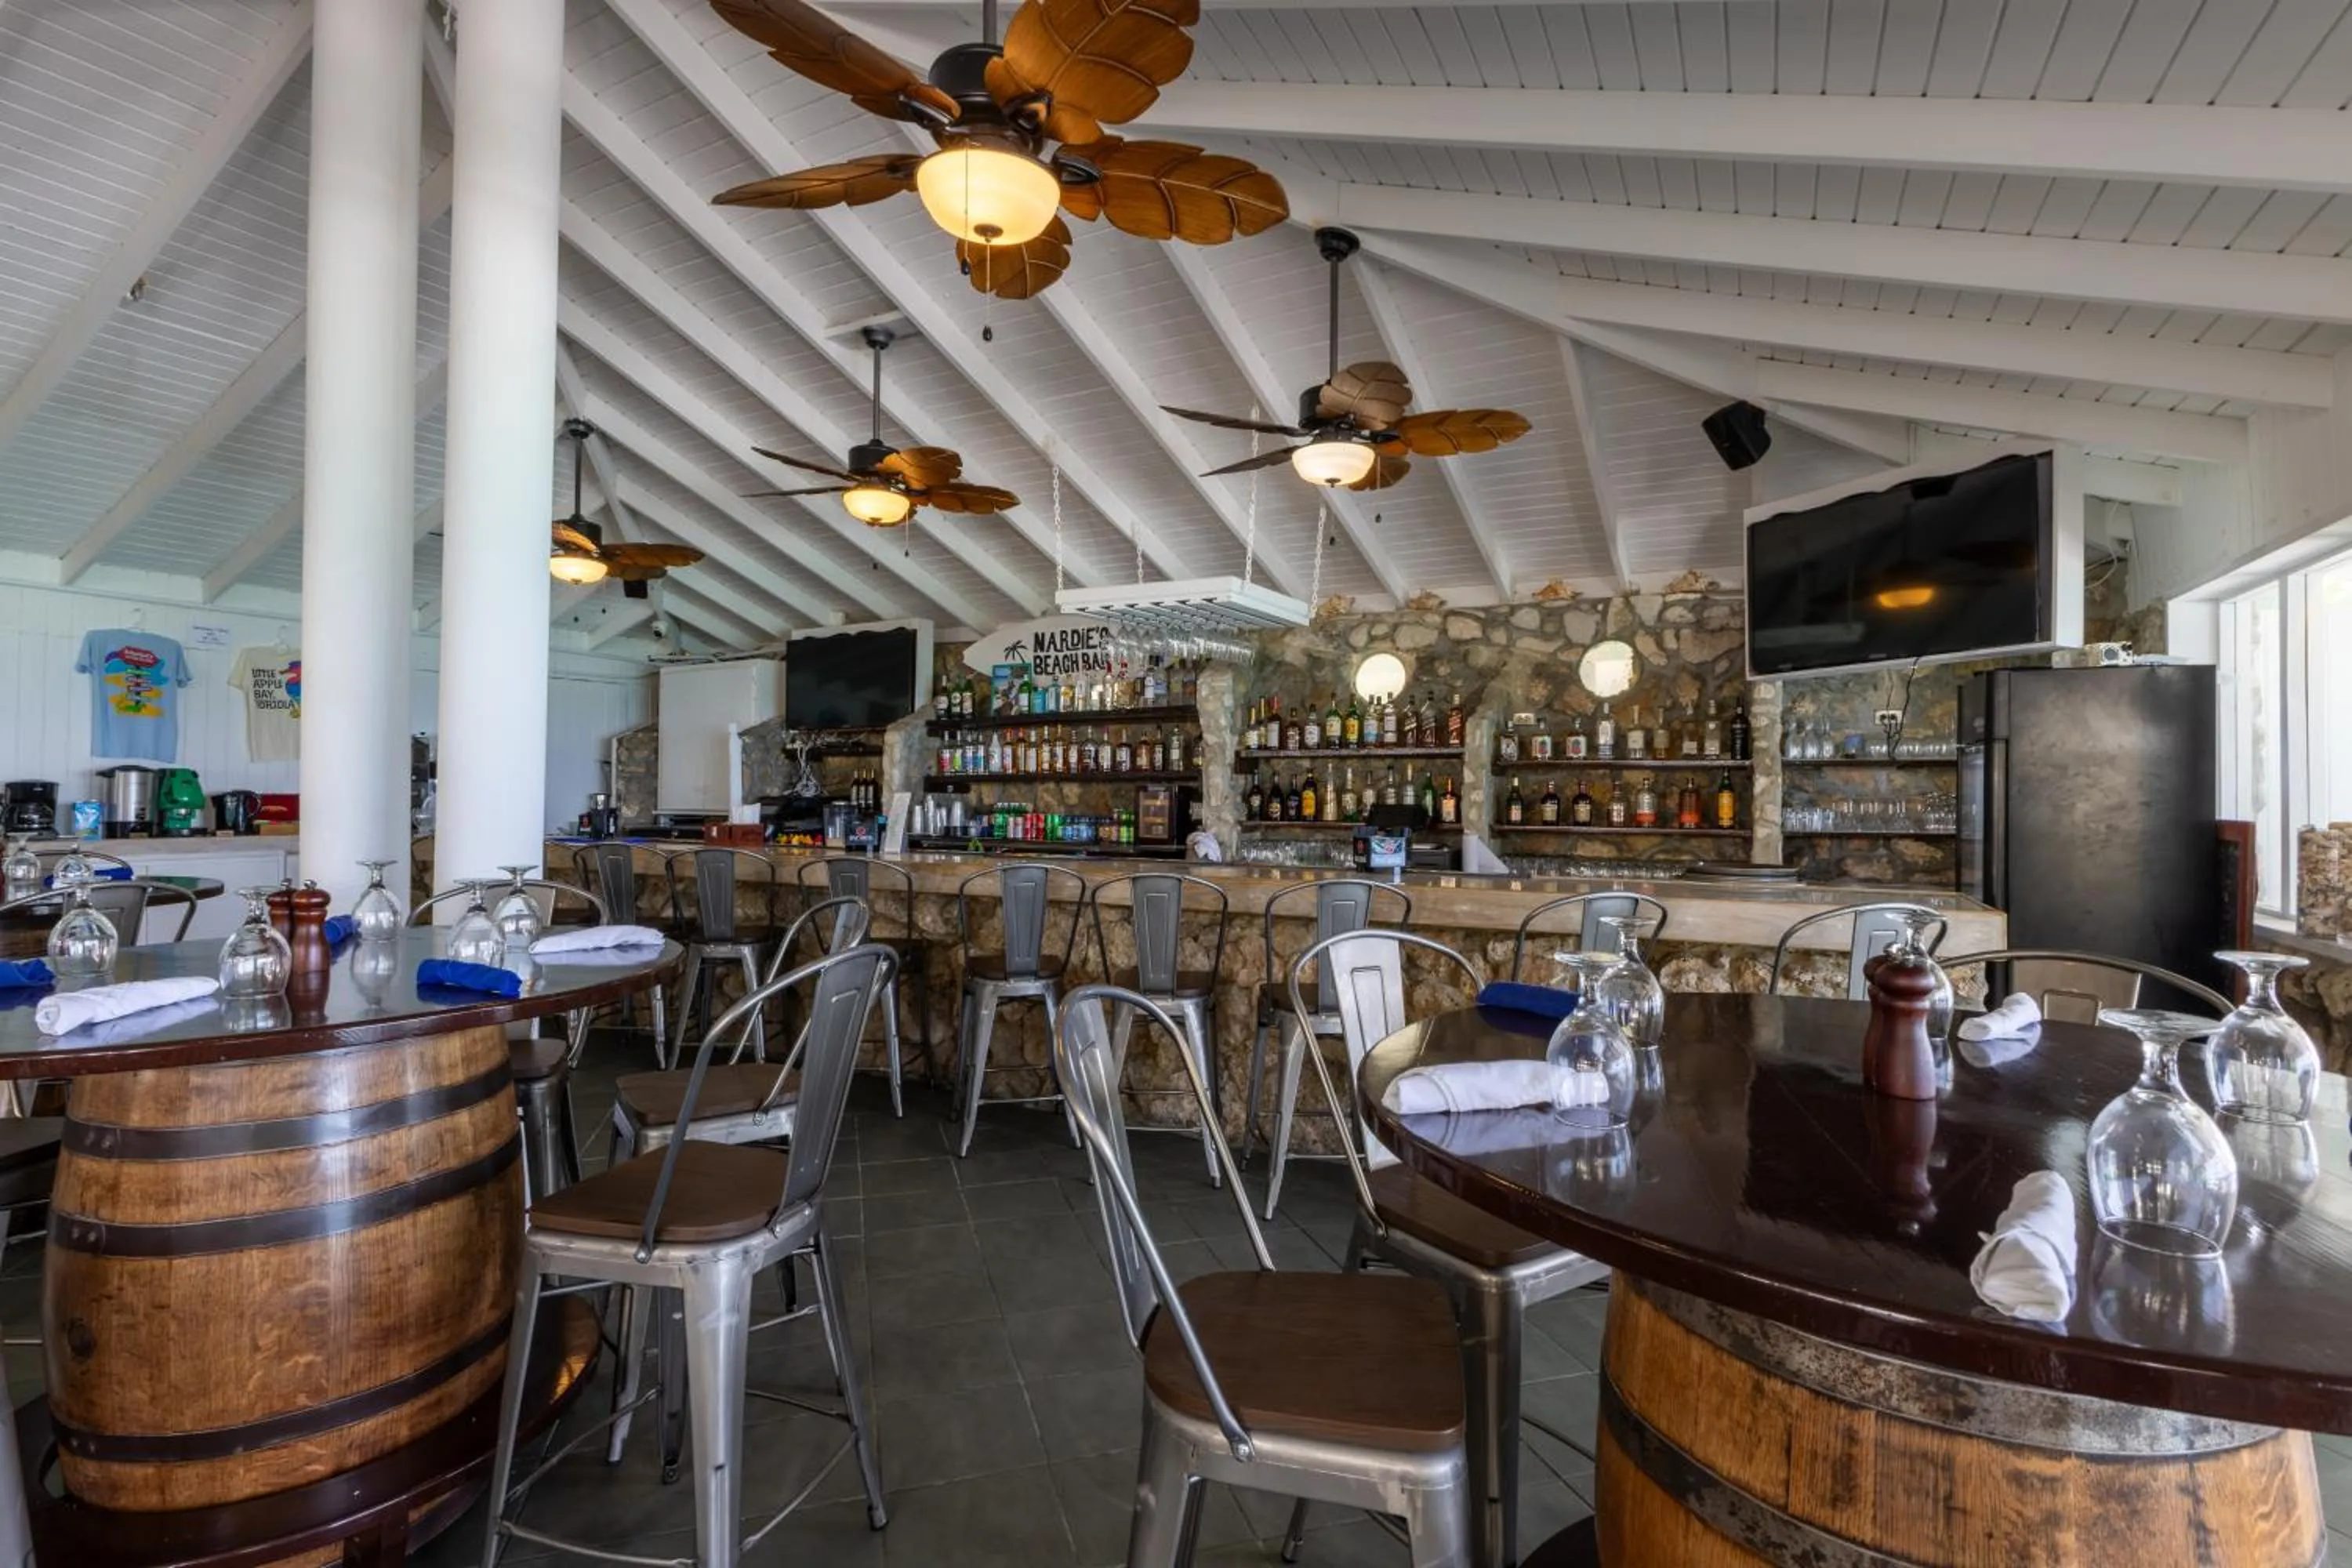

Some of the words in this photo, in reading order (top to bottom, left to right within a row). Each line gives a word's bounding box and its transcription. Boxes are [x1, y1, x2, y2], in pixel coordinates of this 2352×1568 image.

[1033, 653, 1080, 675] BEACH
[252, 668, 276, 678] LITTLE
[253, 679, 283, 689] APPLE
